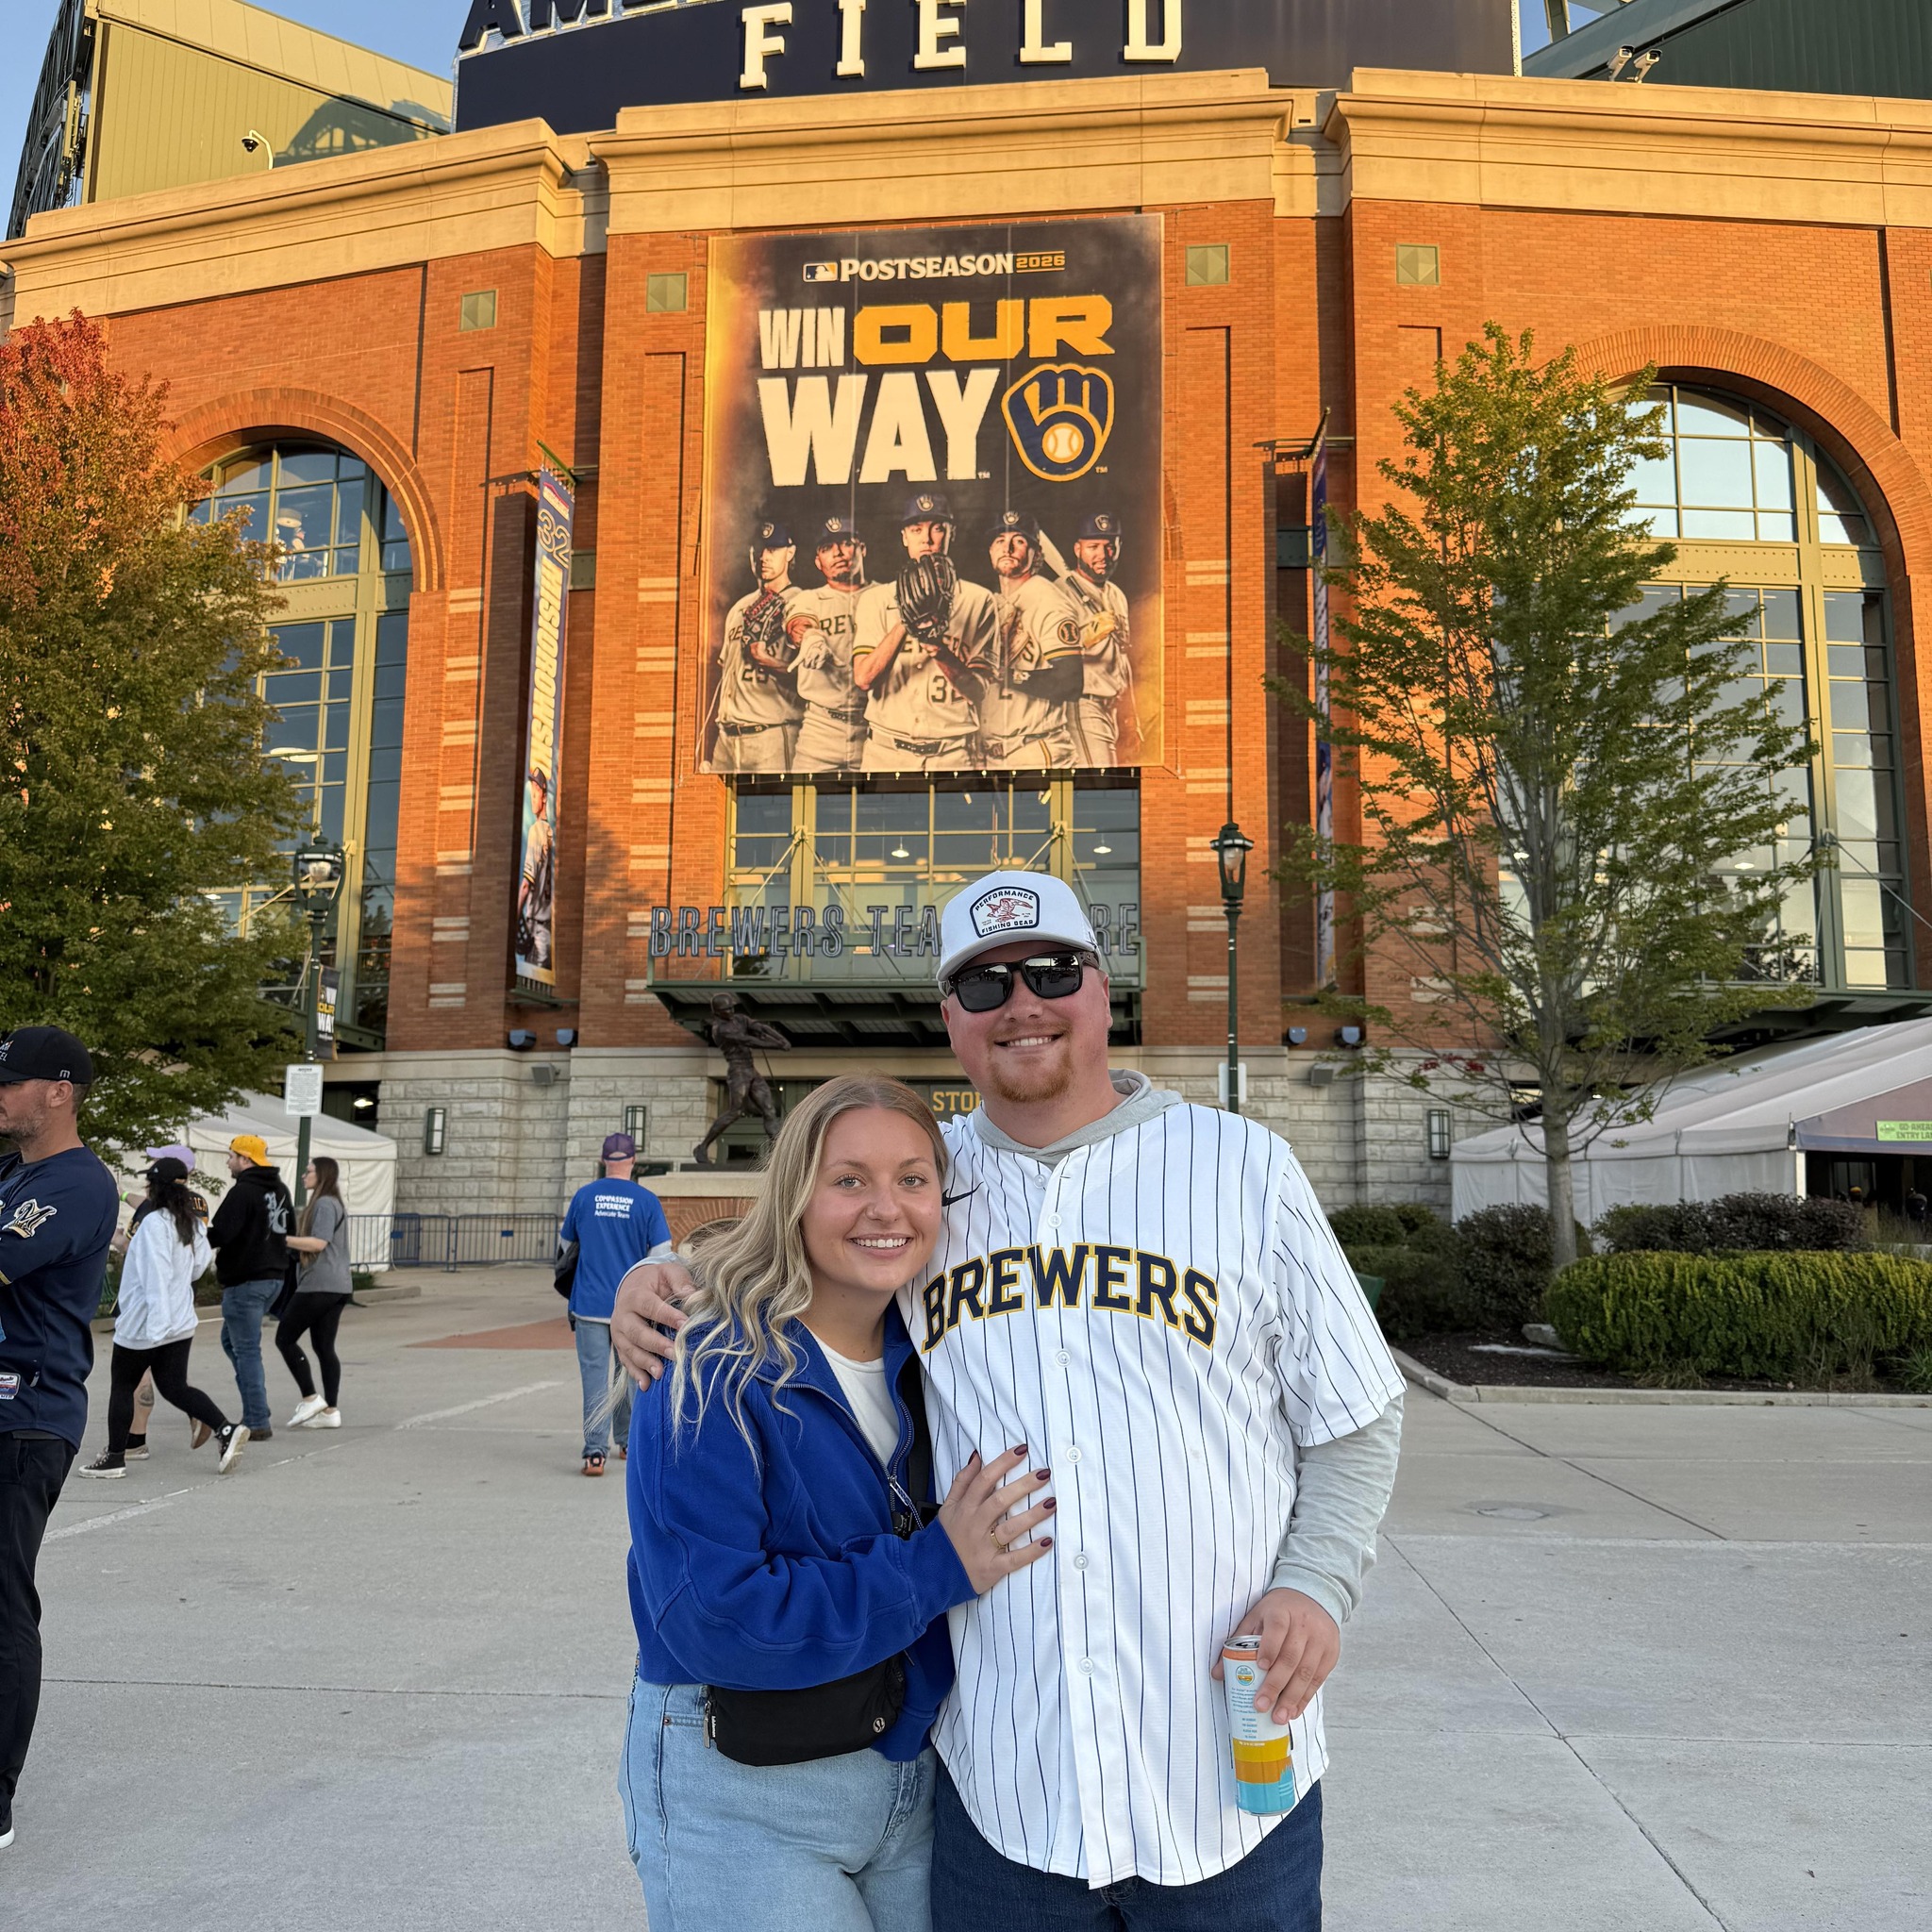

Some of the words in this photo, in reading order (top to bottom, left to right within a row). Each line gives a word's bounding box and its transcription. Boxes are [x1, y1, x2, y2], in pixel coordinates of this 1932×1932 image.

[739, 0, 1182, 90] FIELD
[840, 253, 1014, 281] POSTSEASON
[1016, 255, 1065, 269] 2026
[758, 307, 845, 369] WIN
[853, 294, 1115, 365] OUR
[758, 368, 1001, 486] WAY
[530, 554, 564, 780] MISIOROWSKI
[974, 890, 1034, 911] PERFORMANCE
[651, 905, 844, 958] BREWERS
[866, 906, 941, 957] TEA
[981, 922, 1011, 934] FISHING
[594, 1194, 634, 1206] COMPASSION
[595, 1202, 631, 1212] EXPERIENCE
[921, 1242, 1220, 1355] BREWERS
